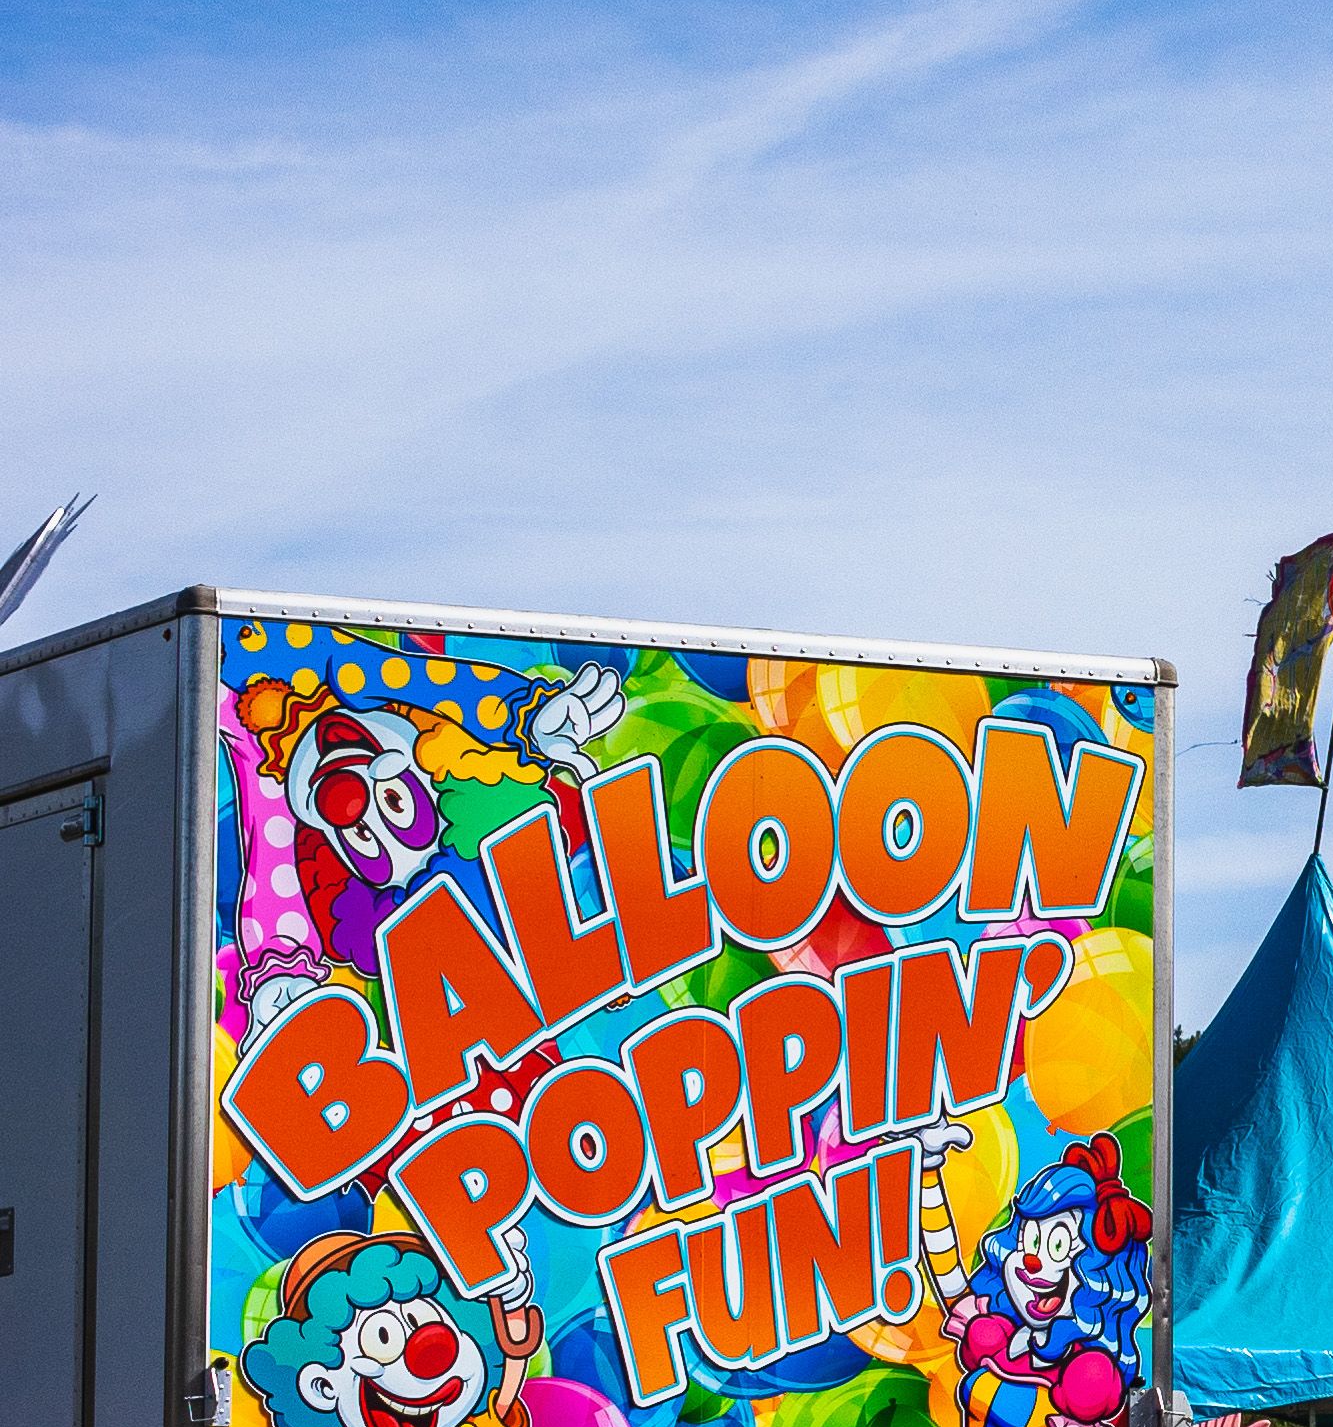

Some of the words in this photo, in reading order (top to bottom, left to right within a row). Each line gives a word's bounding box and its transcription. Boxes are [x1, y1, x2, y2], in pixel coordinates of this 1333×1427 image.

[223, 718, 1143, 1201] BALLOON
[391, 933, 1074, 1298] POPPIN'
[600, 1137, 921, 1407] FUN!
